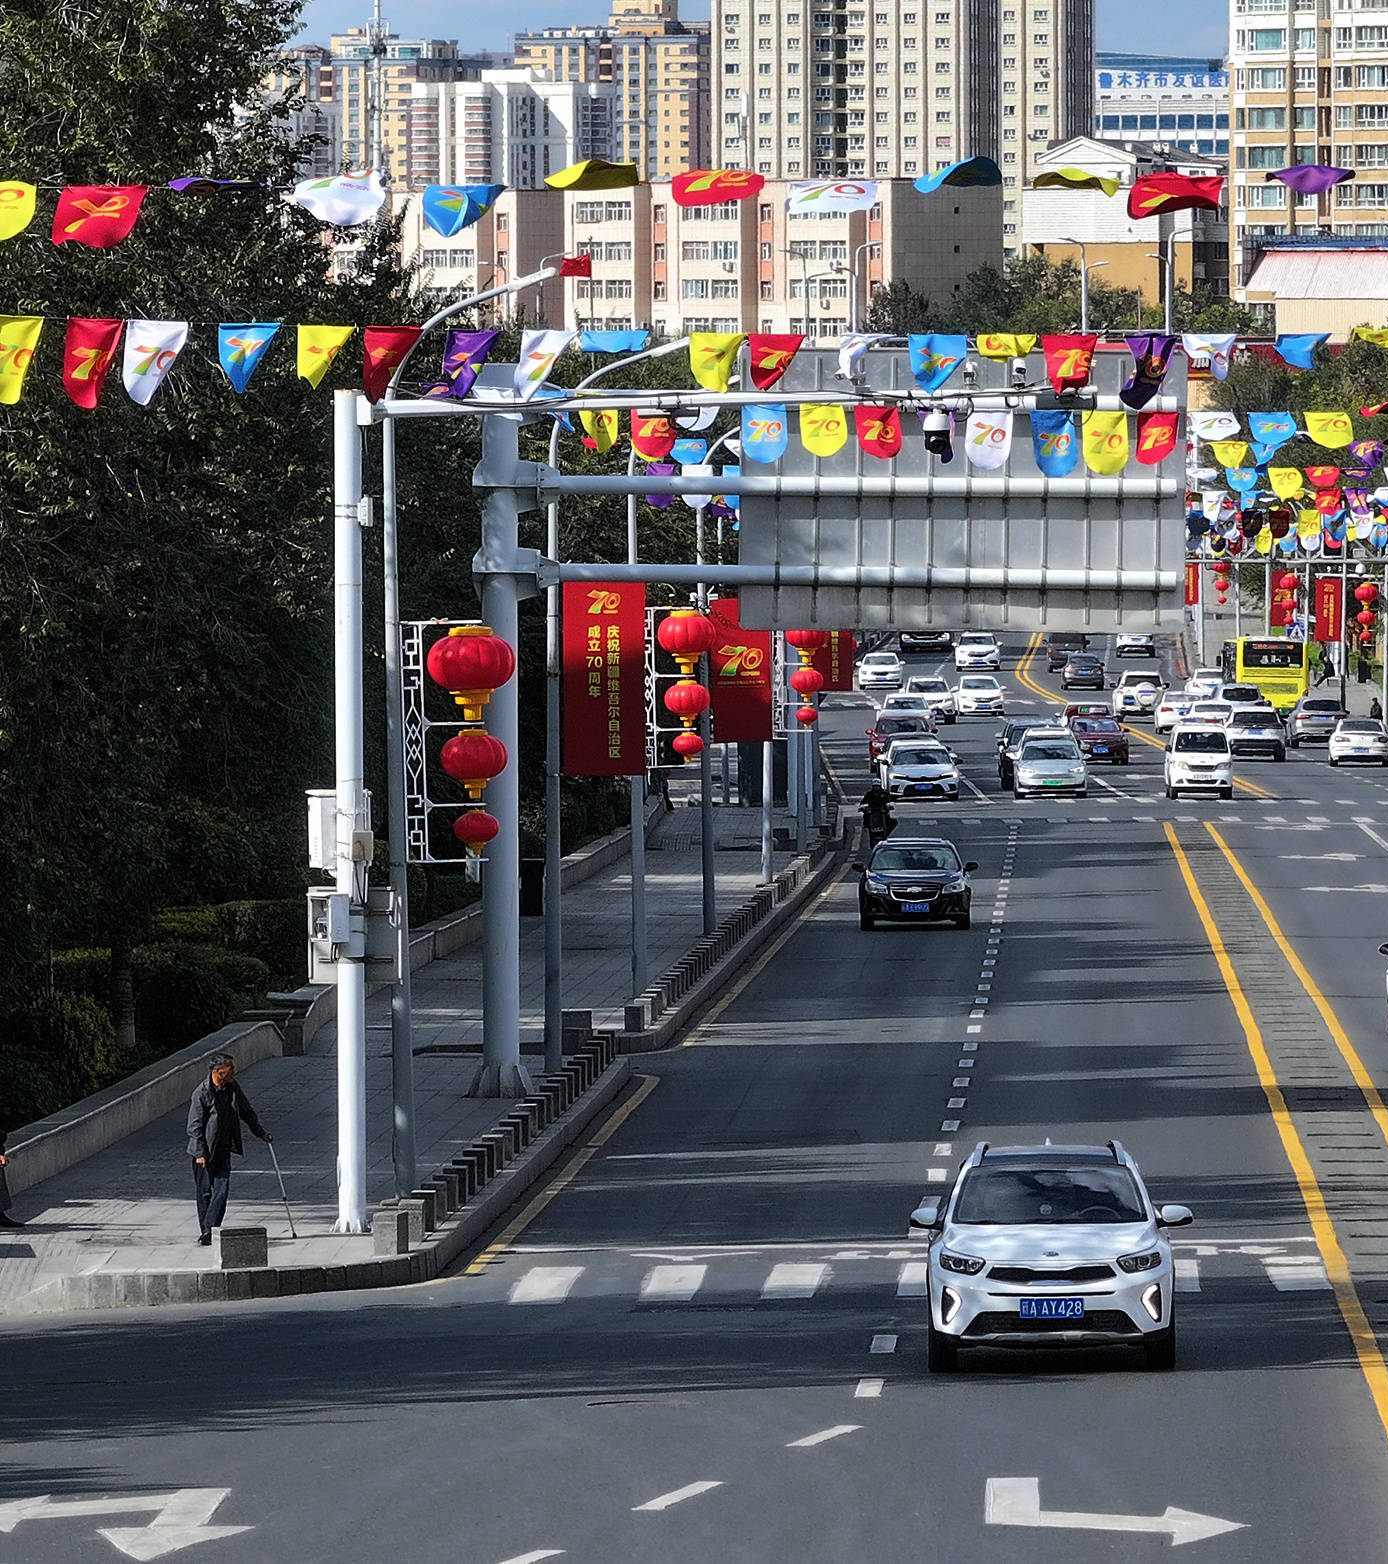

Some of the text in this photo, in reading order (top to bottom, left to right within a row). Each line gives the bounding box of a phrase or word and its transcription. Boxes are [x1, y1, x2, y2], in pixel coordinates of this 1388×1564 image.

[748, 420, 782, 442] 70
[807, 419, 840, 438] 70
[862, 419, 896, 440] 70
[972, 422, 1006, 445] 70
[1142, 426, 1174, 450] 70
[1039, 432, 1070, 456] 70
[1090, 430, 1123, 453] 70
[586, 590, 621, 614] 70
[586, 625, 602, 698] 成立70周年
[718, 644, 763, 676] 70
[607, 625, 621, 758] 庆祝新疆维吾尔自治区
